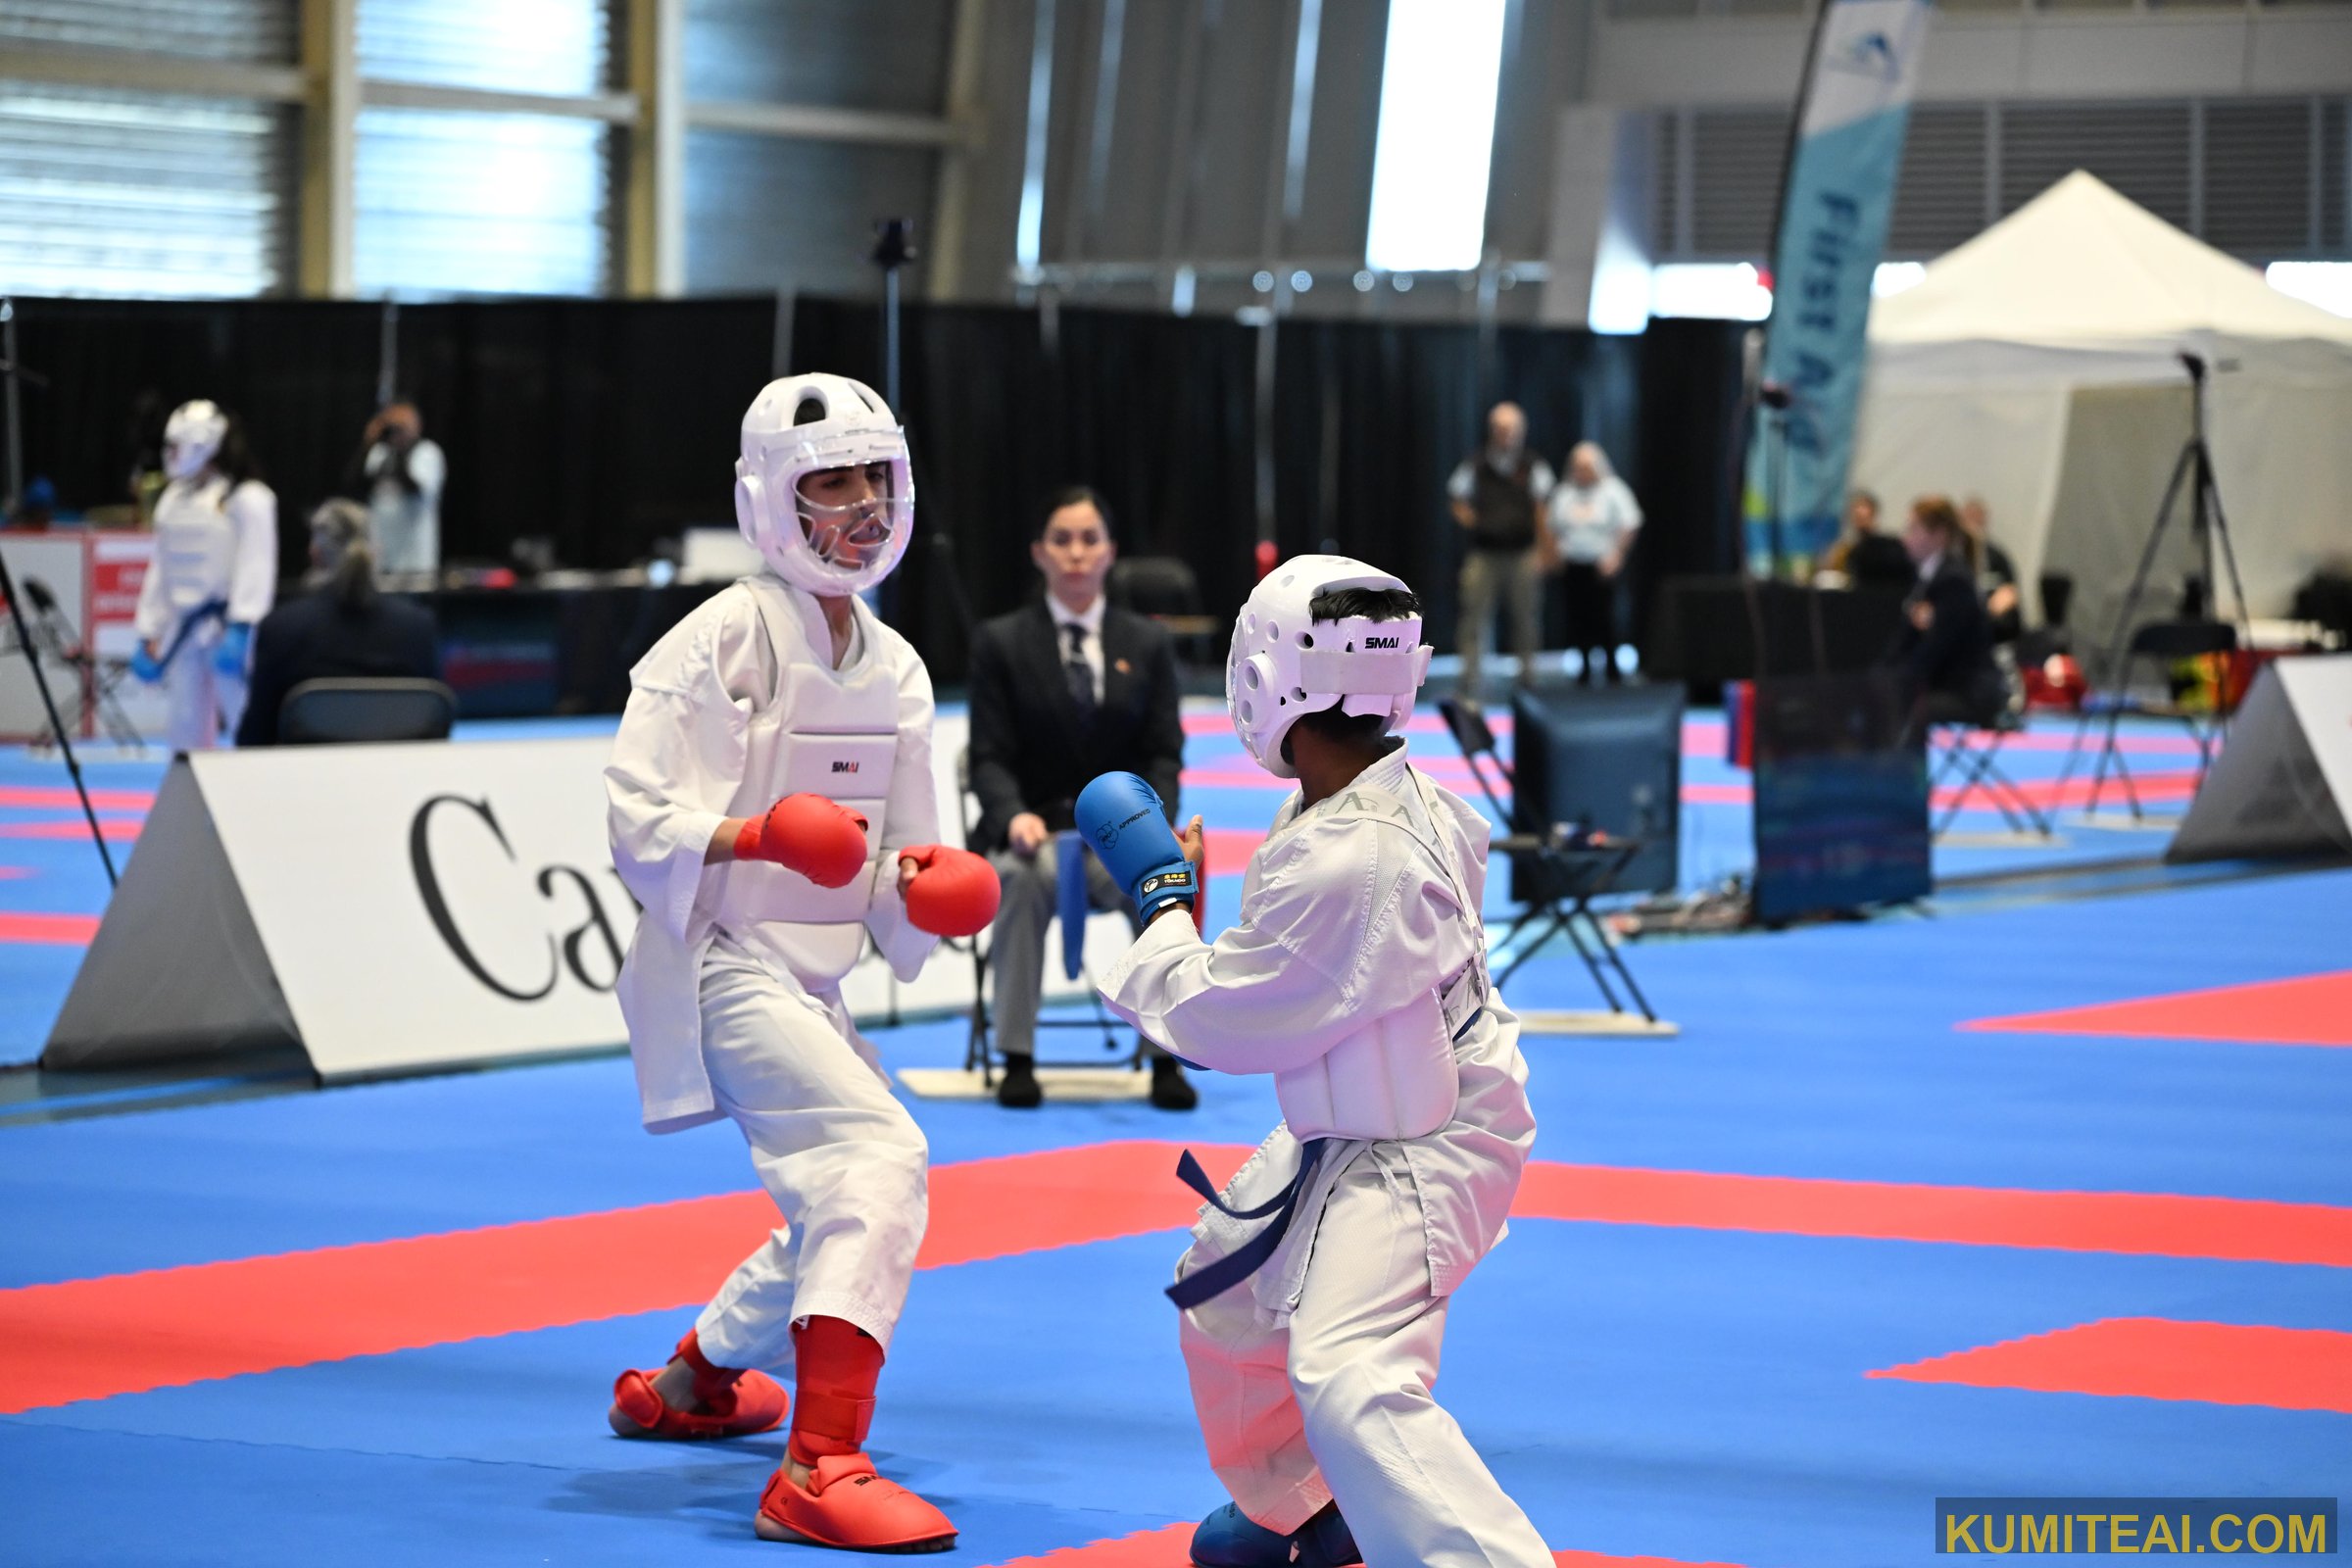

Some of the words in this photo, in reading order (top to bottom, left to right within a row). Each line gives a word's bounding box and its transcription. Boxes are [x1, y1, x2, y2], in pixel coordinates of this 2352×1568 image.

[1798, 191, 1860, 331] First
[1364, 637, 1399, 649] SMAI
[831, 760, 859, 773] SMAI
[1119, 808, 1151, 830] APPROVED
[408, 792, 645, 1003] Ca
